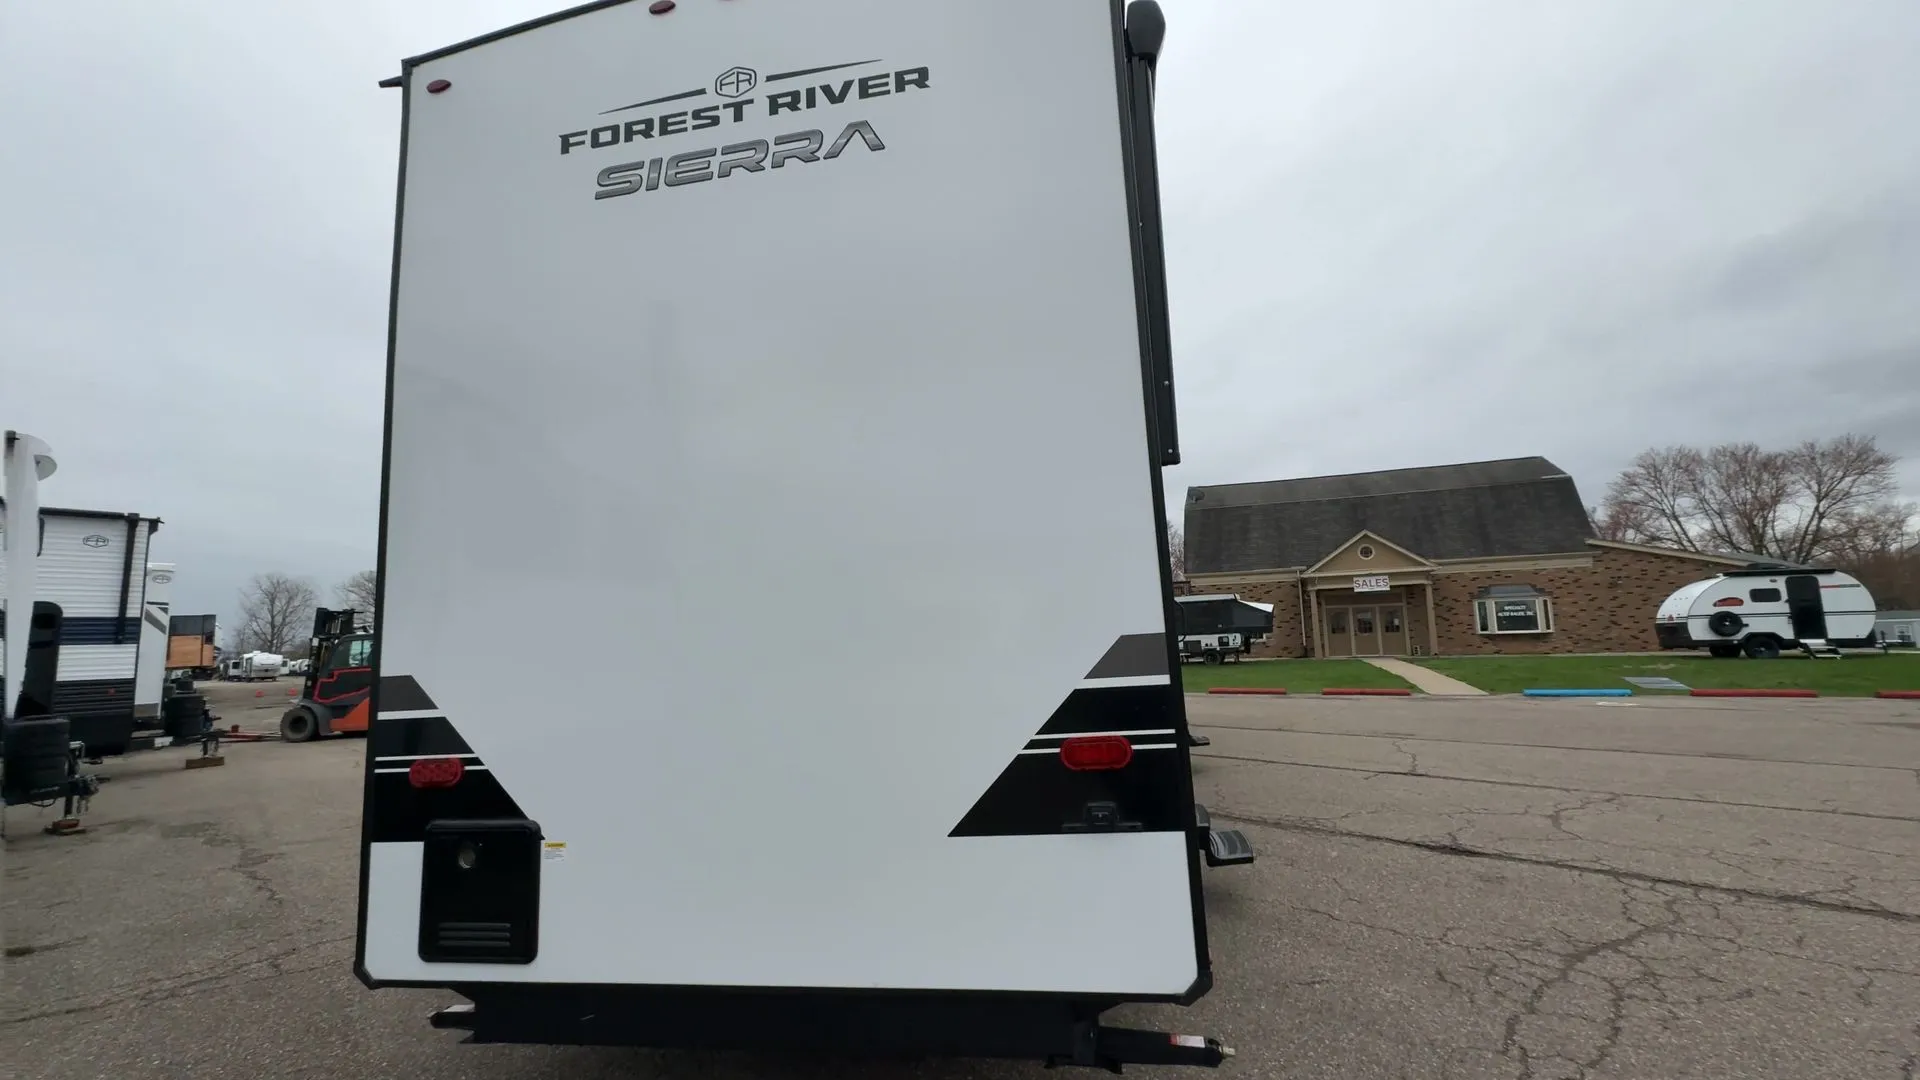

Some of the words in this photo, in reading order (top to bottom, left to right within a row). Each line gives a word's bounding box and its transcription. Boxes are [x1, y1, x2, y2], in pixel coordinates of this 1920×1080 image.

[558, 98, 754, 155] FOREST
[766, 67, 931, 116] RIVER
[594, 120, 886, 200] SIERRA
[1354, 578, 1389, 588] SALES
